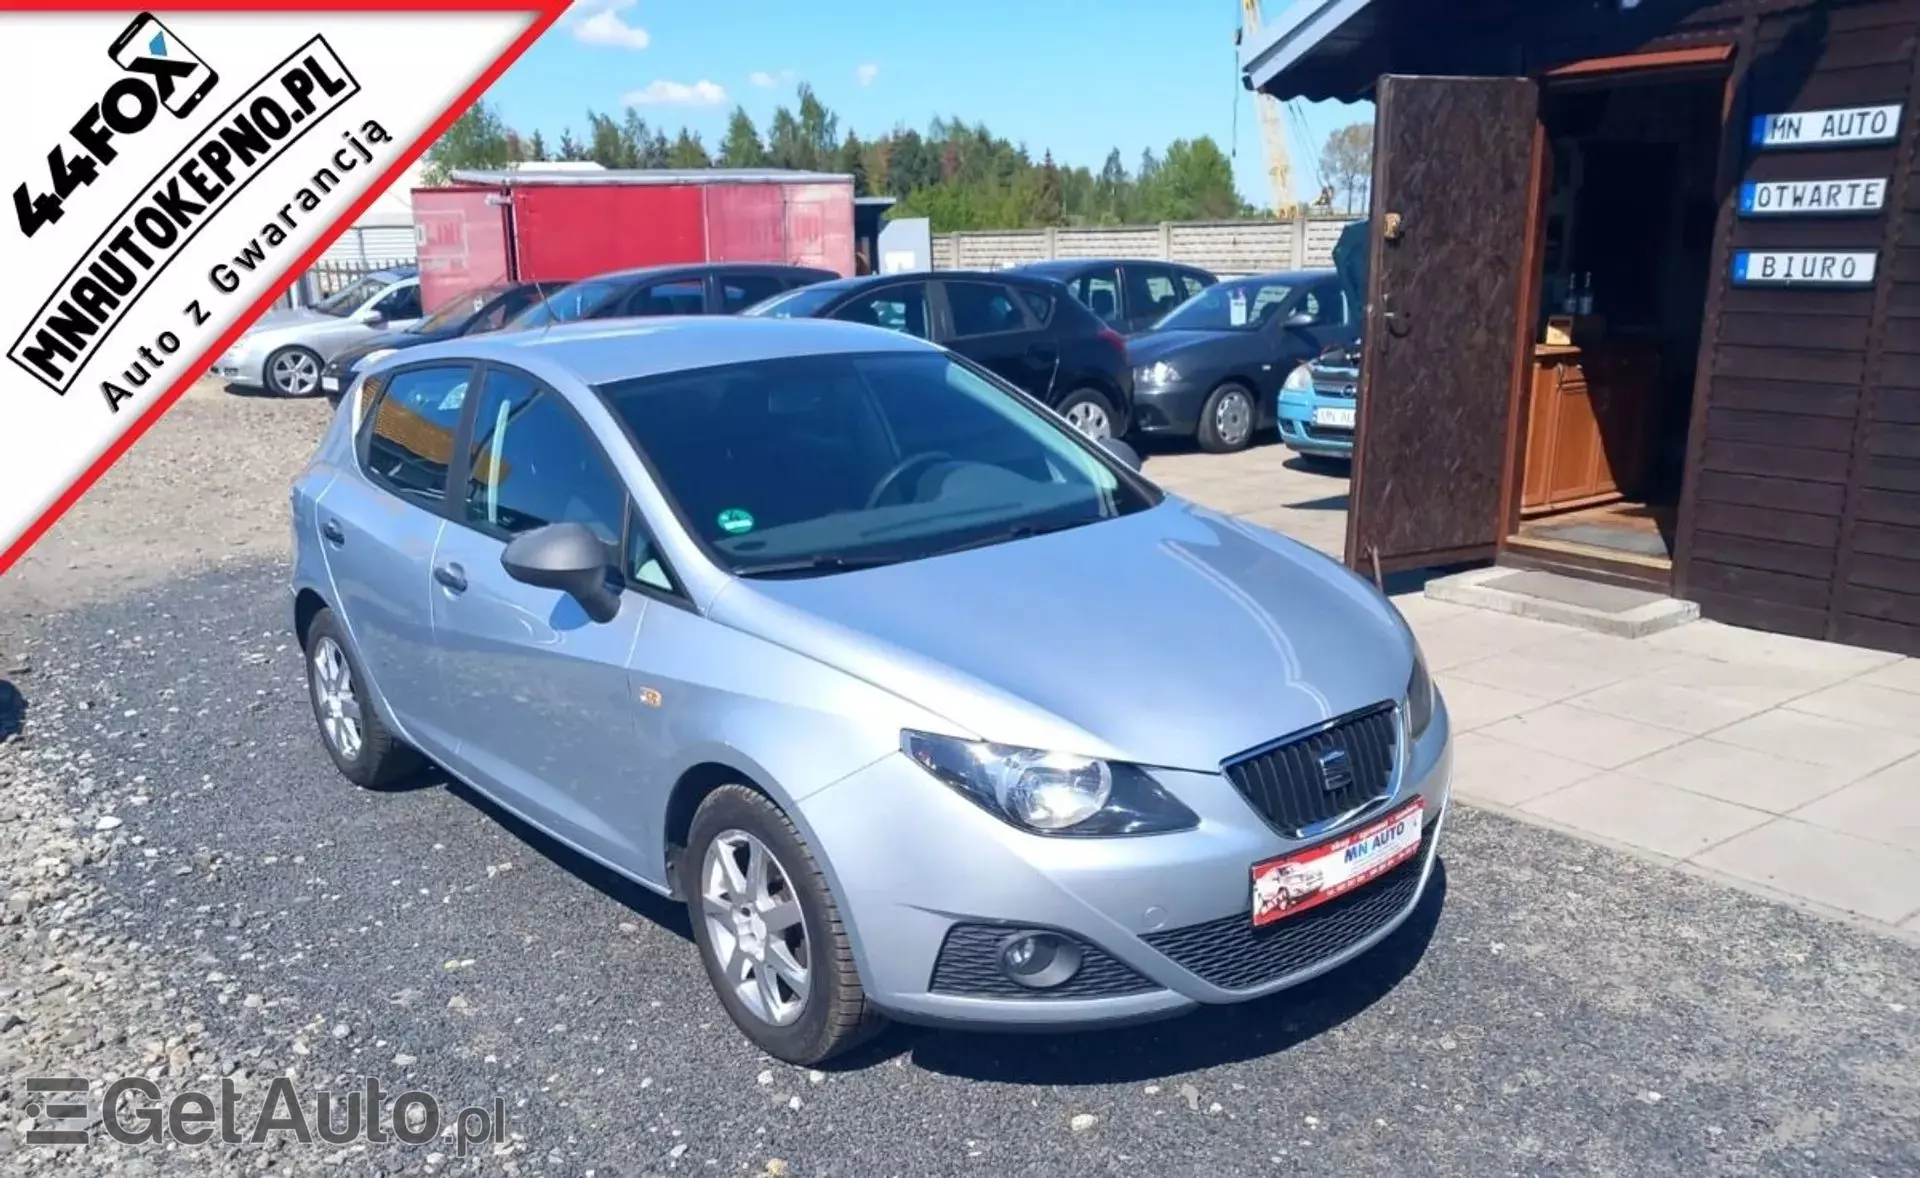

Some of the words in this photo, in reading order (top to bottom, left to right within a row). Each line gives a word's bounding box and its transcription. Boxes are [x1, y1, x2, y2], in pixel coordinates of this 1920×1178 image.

[1771, 116, 1802, 140] MN
[1821, 110, 1887, 137] AUTO
[1757, 182, 1880, 208] OTWARTE
[1761, 256, 1856, 278] BIURO
[1344, 842, 1368, 864] MN
[1372, 821, 1405, 848] AUTO
